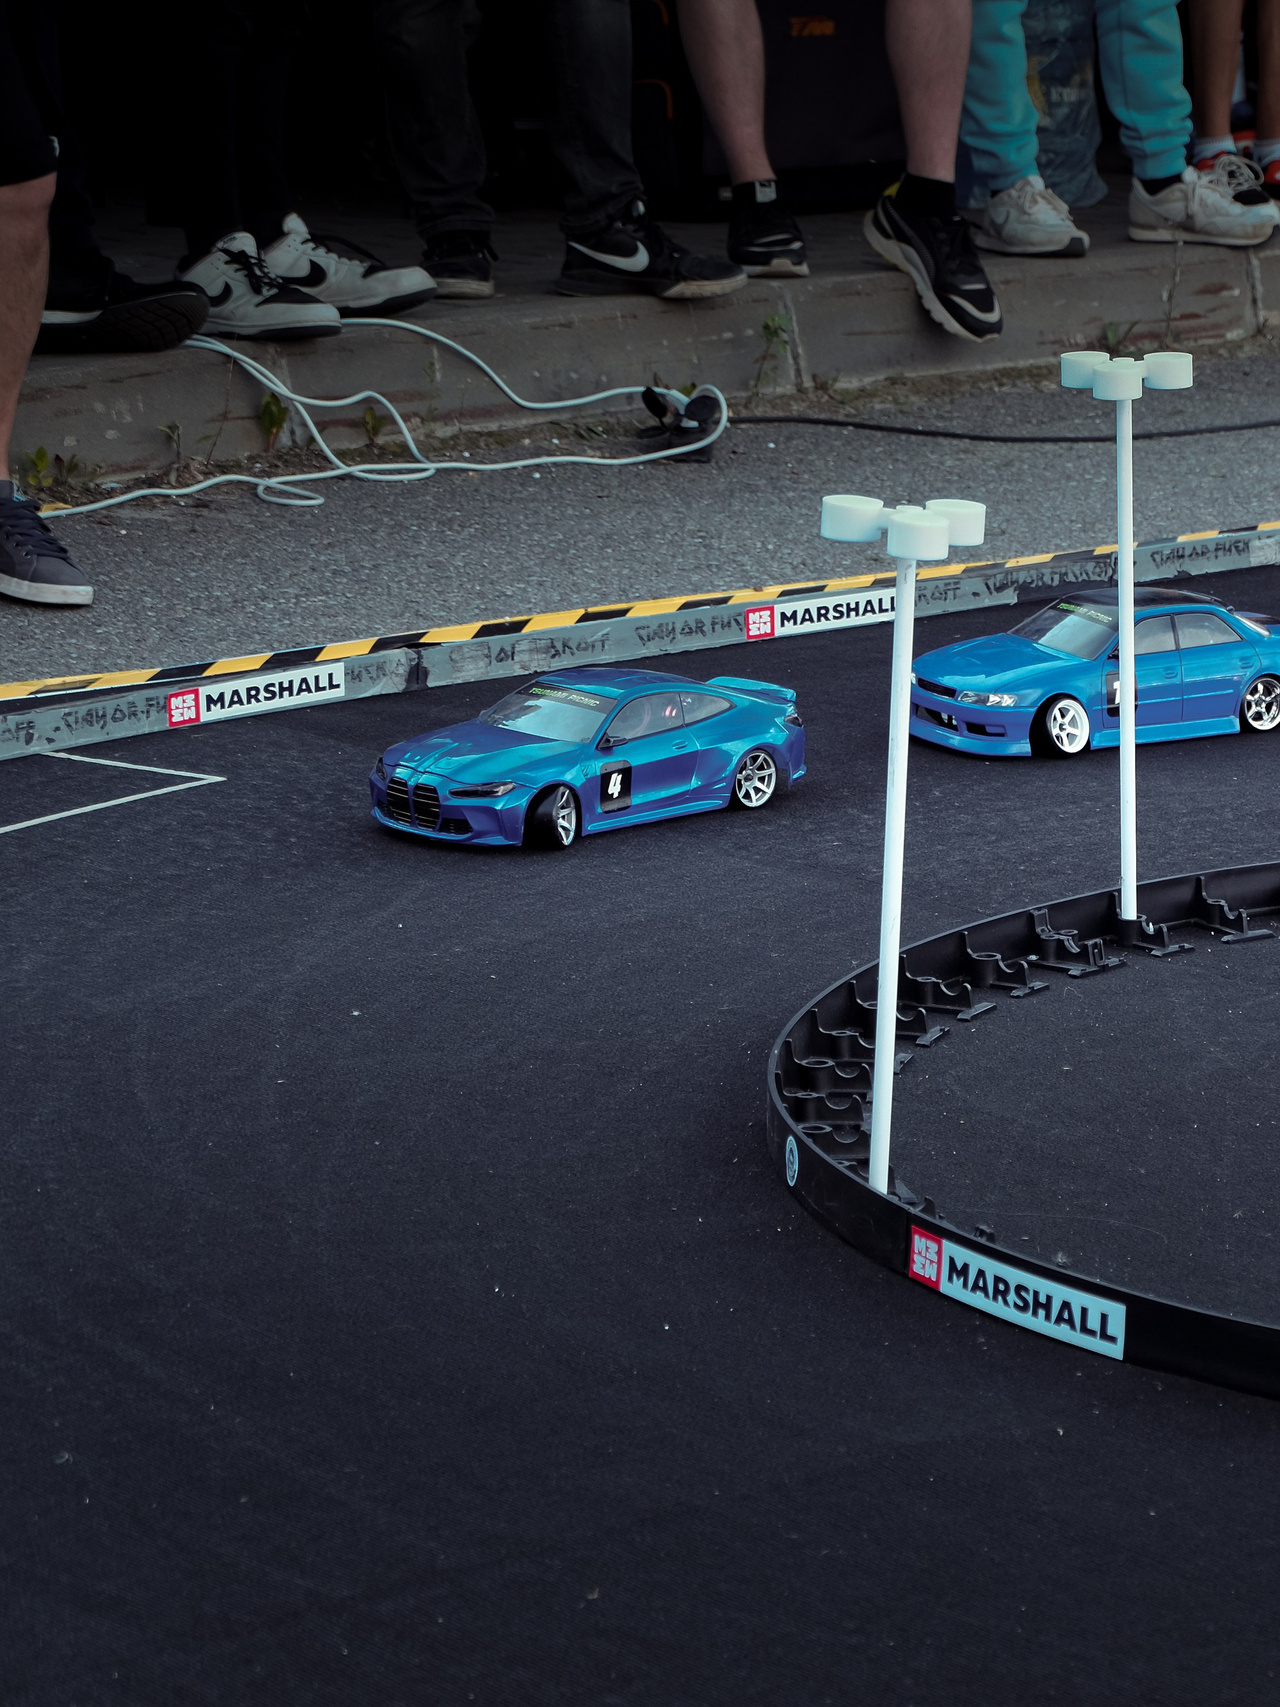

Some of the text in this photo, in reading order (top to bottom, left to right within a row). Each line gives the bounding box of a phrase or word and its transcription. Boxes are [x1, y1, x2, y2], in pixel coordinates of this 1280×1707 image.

[206, 672, 341, 713] MARSHALL
[567, 694, 600, 707] PICNIC
[608, 772, 623, 799] 4
[947, 1255, 1119, 1347] MARSHALL
